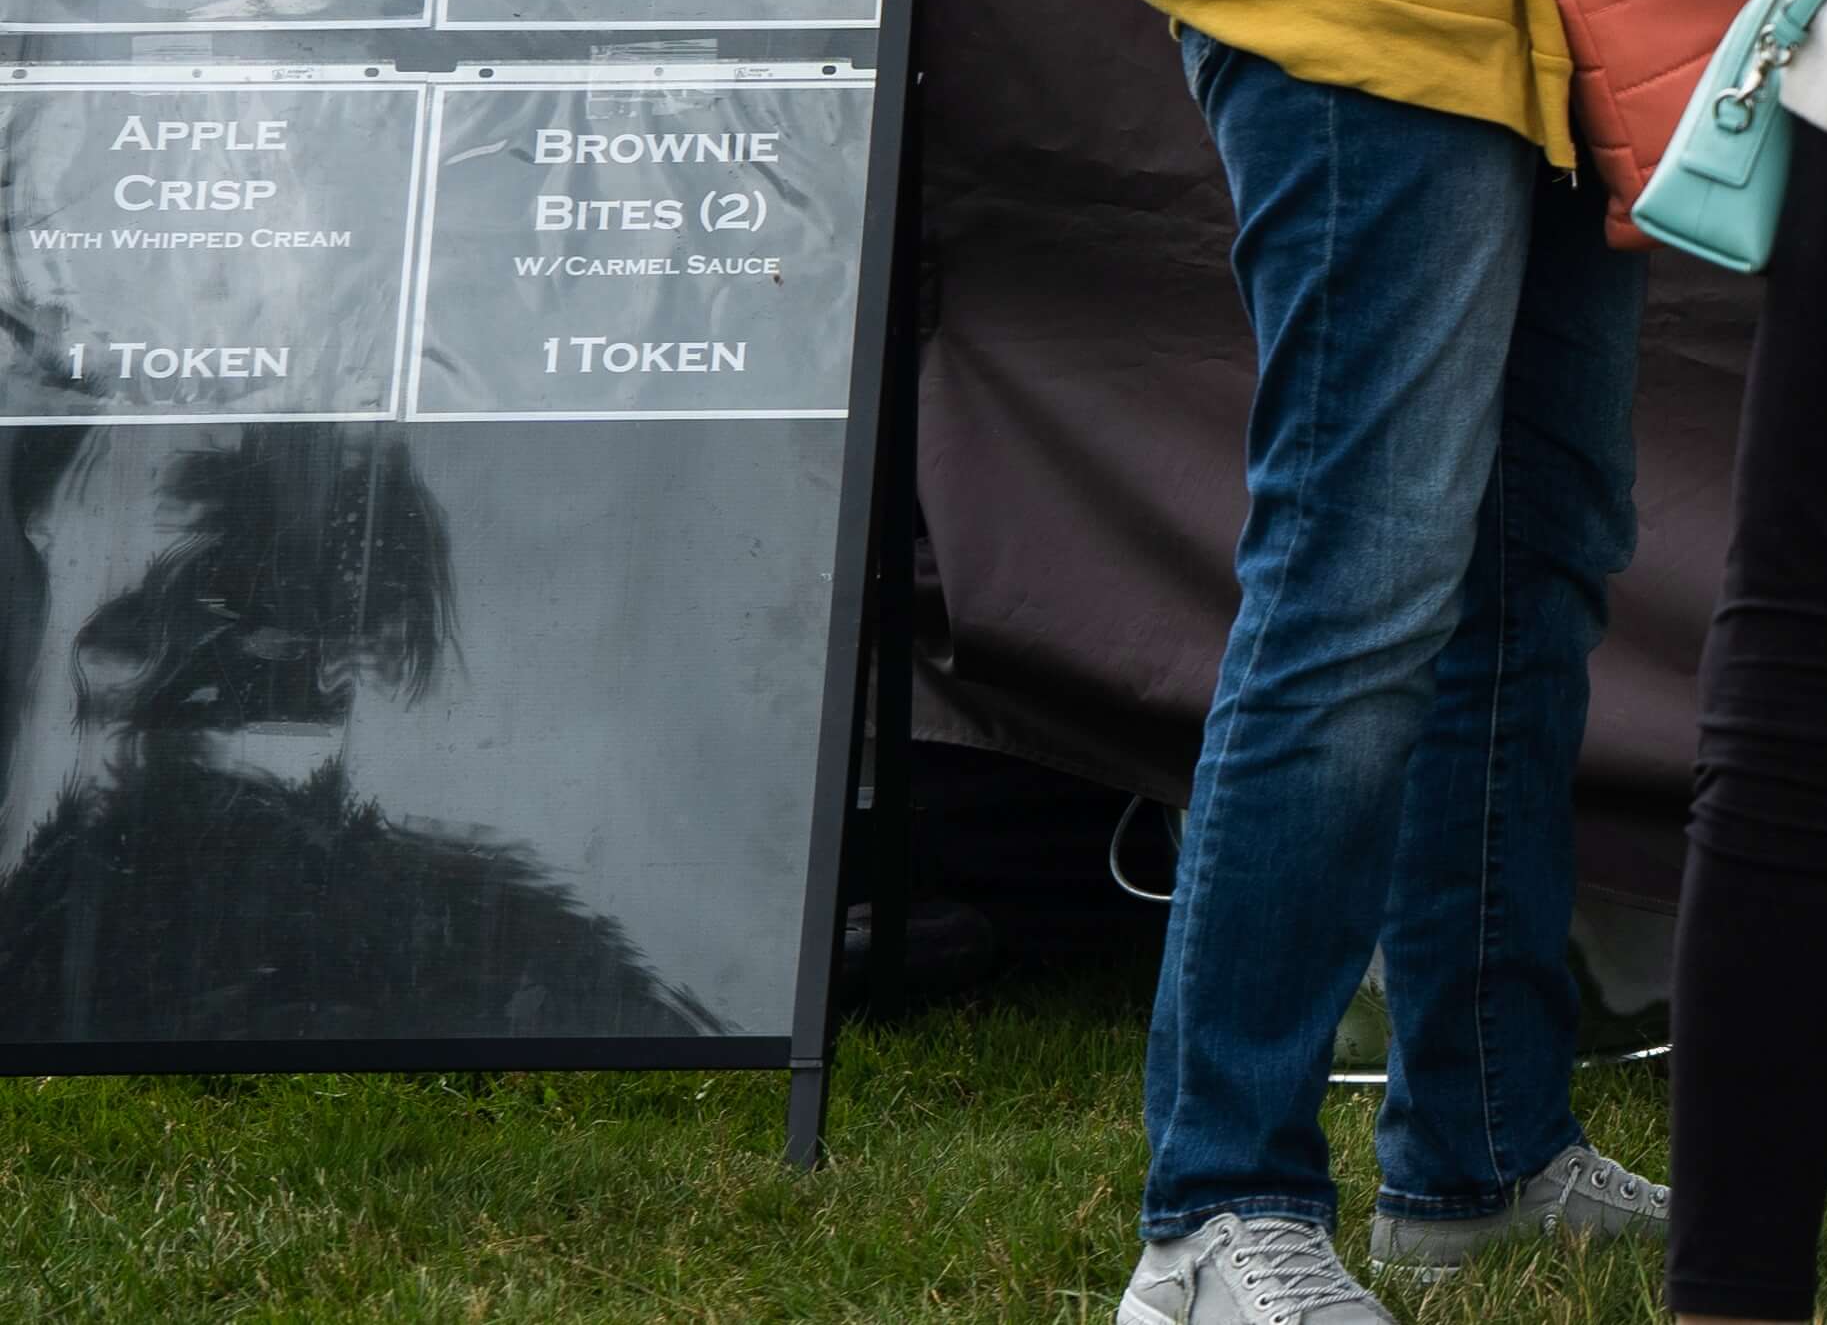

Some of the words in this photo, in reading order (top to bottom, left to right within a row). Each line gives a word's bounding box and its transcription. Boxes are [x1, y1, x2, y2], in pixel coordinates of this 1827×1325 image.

[109, 115, 288, 151] APPLE
[533, 128, 780, 165] BROWNIE
[113, 174, 277, 211] CRISP
[534, 195, 683, 231] BITES
[700, 190, 767, 232] (2)
[29, 229, 103, 250] WITH
[110, 228, 244, 249] WHIPPED
[250, 228, 352, 249] CREAM
[686, 255, 781, 276] SAUCE
[69, 343, 84, 380] 1
[109, 341, 290, 379] TOKEN
